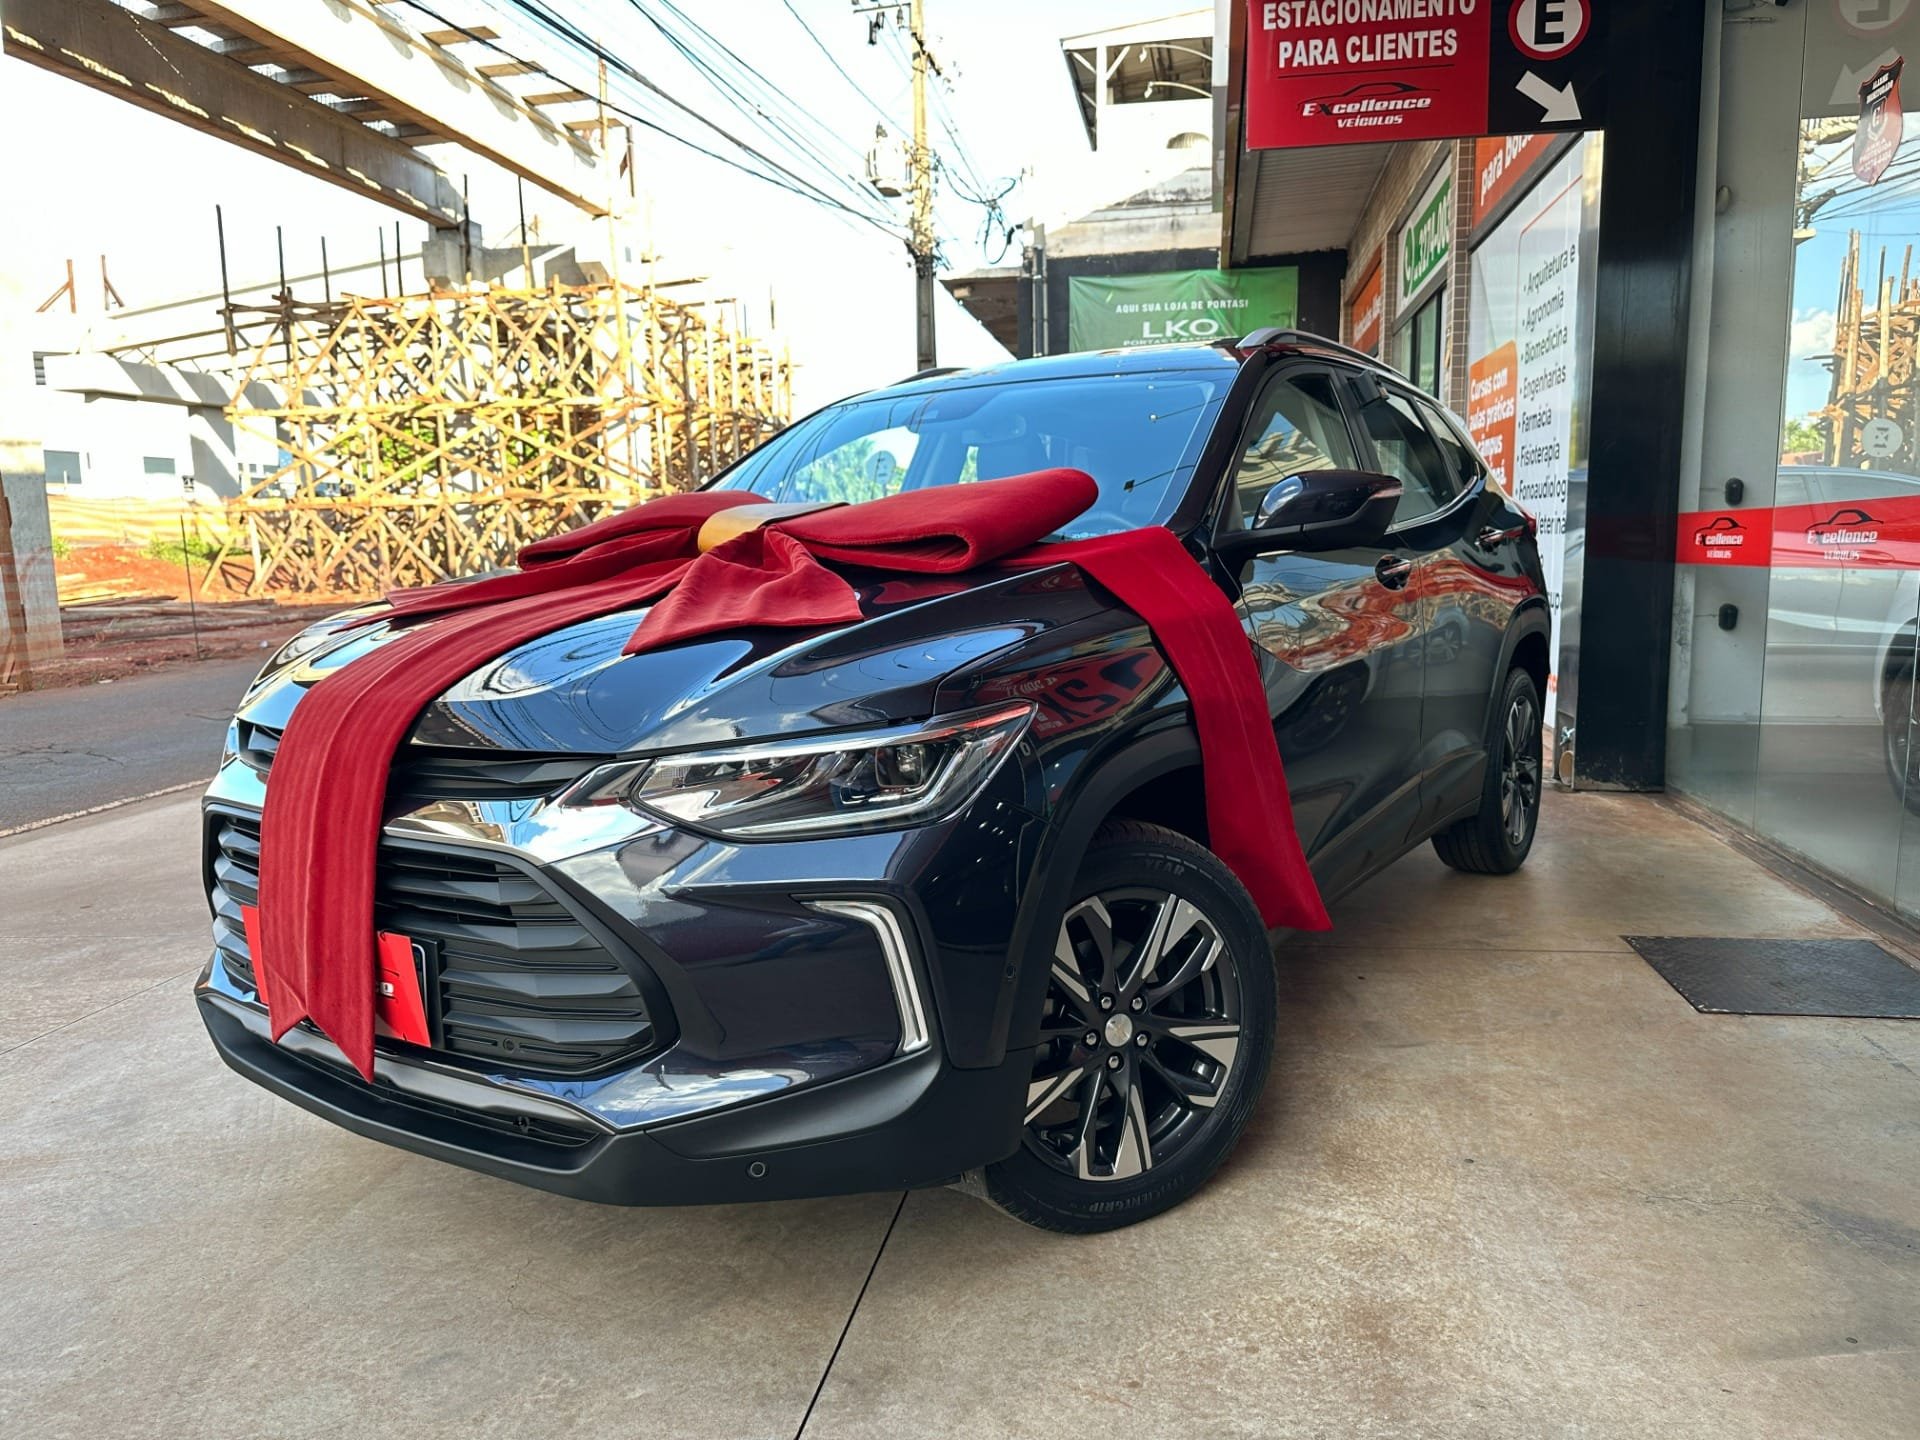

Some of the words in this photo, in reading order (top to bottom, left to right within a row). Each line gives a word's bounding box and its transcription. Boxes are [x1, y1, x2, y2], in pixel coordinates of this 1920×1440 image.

[1263, 0, 1475, 30] ESTACIONAMENTO
[1534, 0, 1565, 45] E
[1279, 38, 1339, 68] PARA
[1345, 28, 1457, 64] CLIENTES
[1337, 114, 1403, 129] VEÍCULOS
[1527, 250, 1568, 296] Arquitetura
[1570, 243, 1576, 263] e
[1115, 303, 1139, 314] AQUI
[1141, 302, 1161, 313] SUA
[1164, 301, 1188, 312] LOJA
[1190, 300, 1204, 311] DE
[1525, 285, 1565, 332] Agronomia
[1142, 318, 1219, 338] LKO
[1524, 323, 1568, 365] Biomedicina
[1522, 361, 1567, 402] Engenharias
[1522, 402, 1552, 433] Farmácia
[1520, 436, 1560, 468] Fisioterapia
